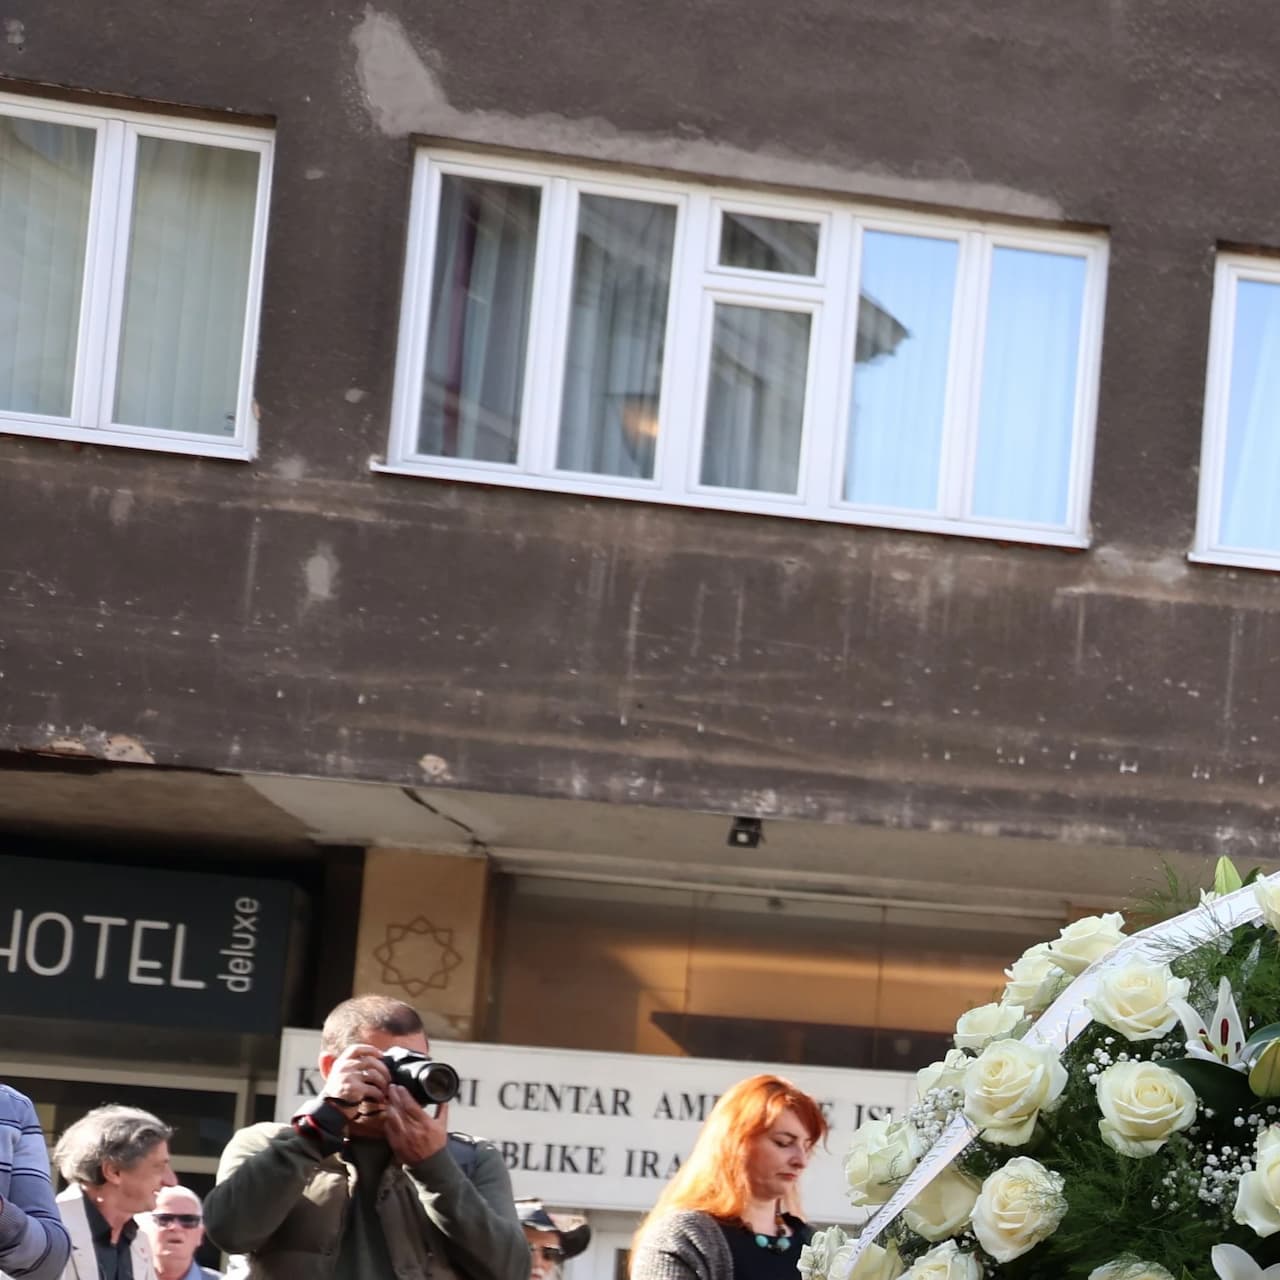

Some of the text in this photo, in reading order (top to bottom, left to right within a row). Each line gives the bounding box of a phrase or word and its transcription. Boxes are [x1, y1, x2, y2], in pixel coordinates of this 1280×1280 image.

[216, 896, 260, 993] deluxe
[497, 1081, 632, 1117] CENTAR
[624, 1149, 682, 1181] IRA
